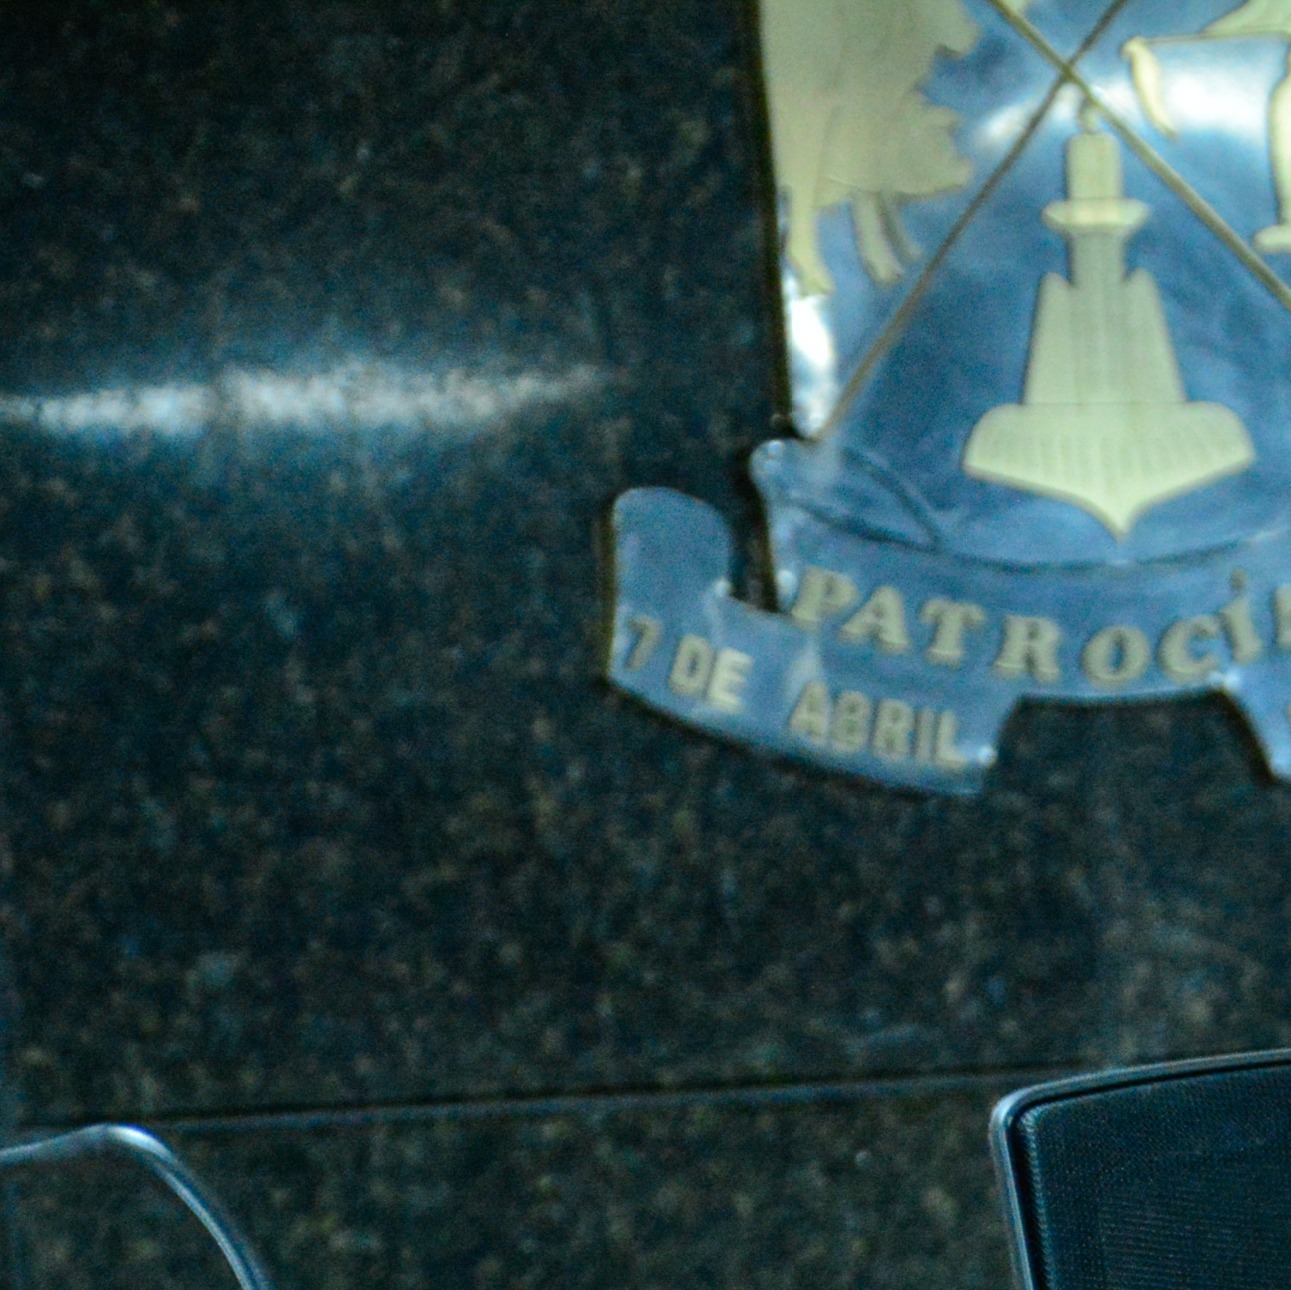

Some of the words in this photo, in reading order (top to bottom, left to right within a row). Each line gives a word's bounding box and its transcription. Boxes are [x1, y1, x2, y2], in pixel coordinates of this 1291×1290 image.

[623, 614, 664, 672] 7
[668, 632, 755, 714] DE
[788, 680, 972, 770] ABRIL
